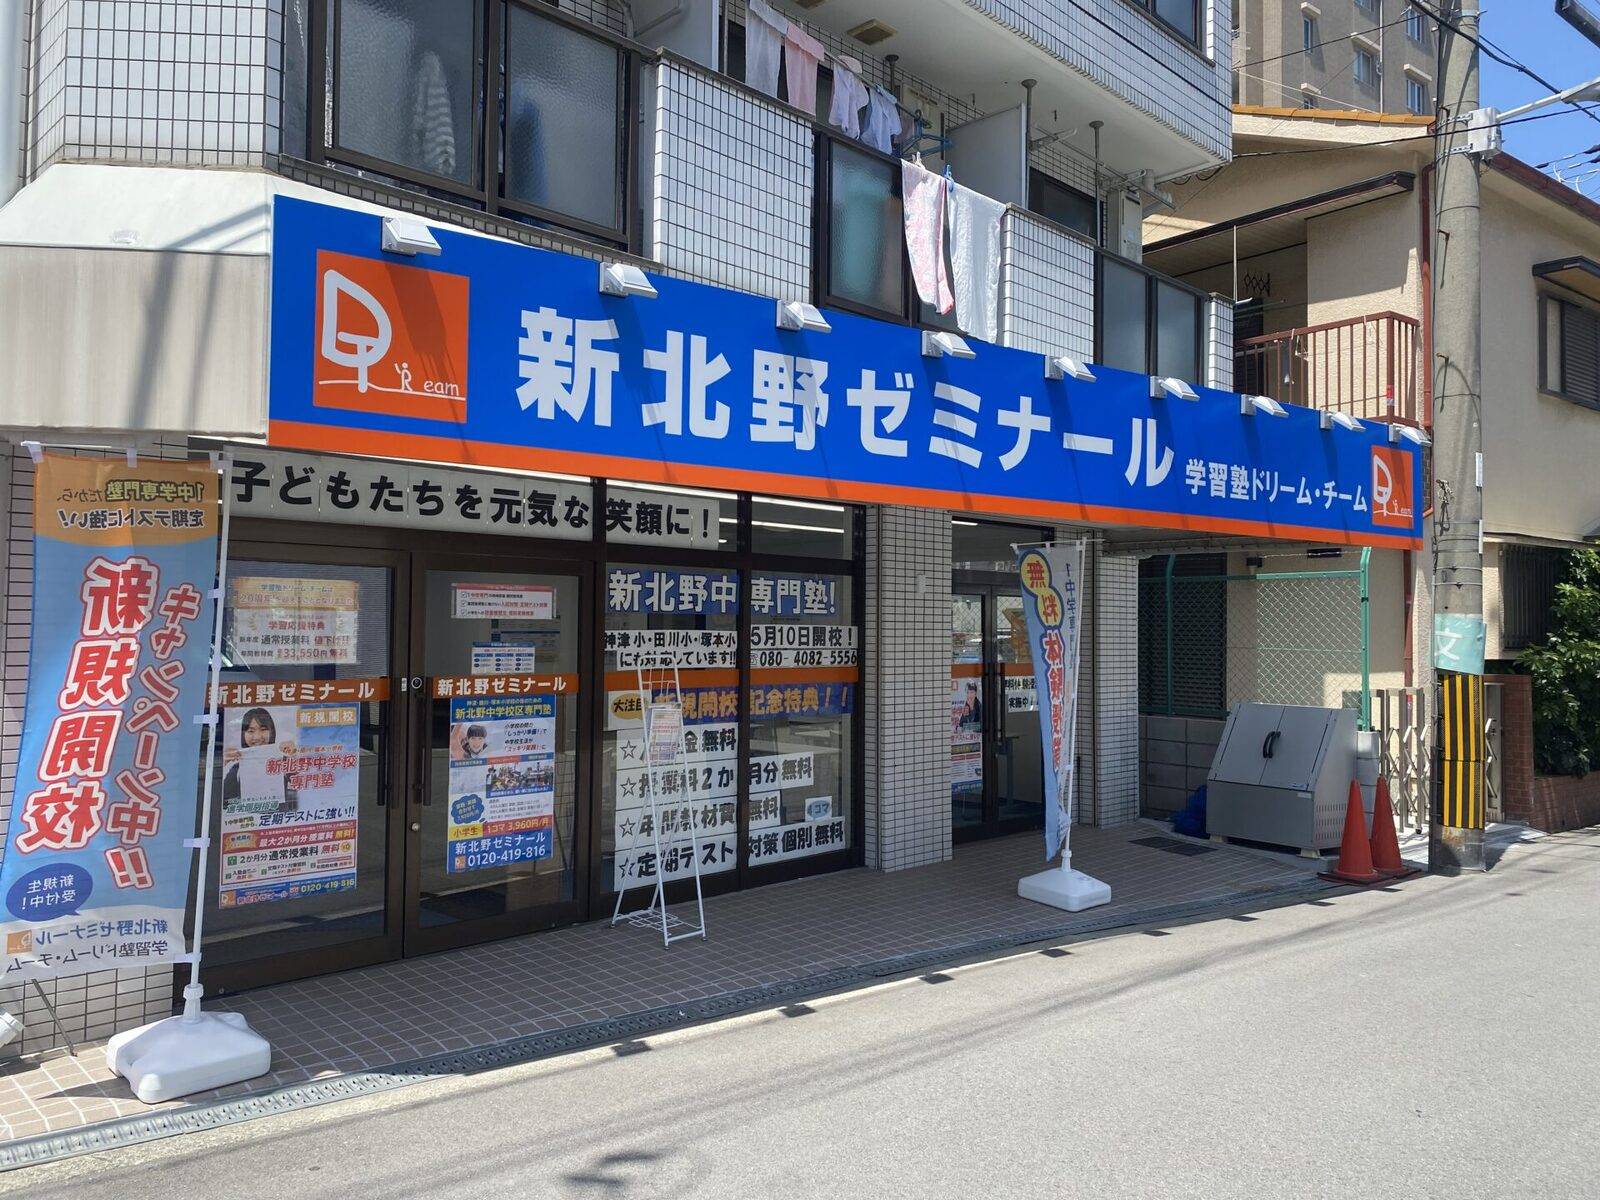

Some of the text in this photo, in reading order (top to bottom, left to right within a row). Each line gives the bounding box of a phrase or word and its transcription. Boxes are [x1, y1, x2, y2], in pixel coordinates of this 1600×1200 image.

[516, 306, 1175, 488] 新北野ゼミナール
[231, 459, 589, 528] 子どもたちを元気な
[1186, 458, 1368, 512] 学習塾ドリーム・チーム
[608, 570, 737, 613] 新北野中
[208, 682, 375, 705] 新北野ゼミナール
[438, 676, 567, 696] 新北野ゼミナール
[455, 704, 552, 719] 新北野中学校区専門塾
[266, 754, 357, 775] 新北野中学校
[289, 771, 335, 791] 専門塾
[453, 826, 478, 838] 小学生
[455, 834, 546, 853] 新北野ゼミナール
[467, 846, 546, 867] 0120-419-816
